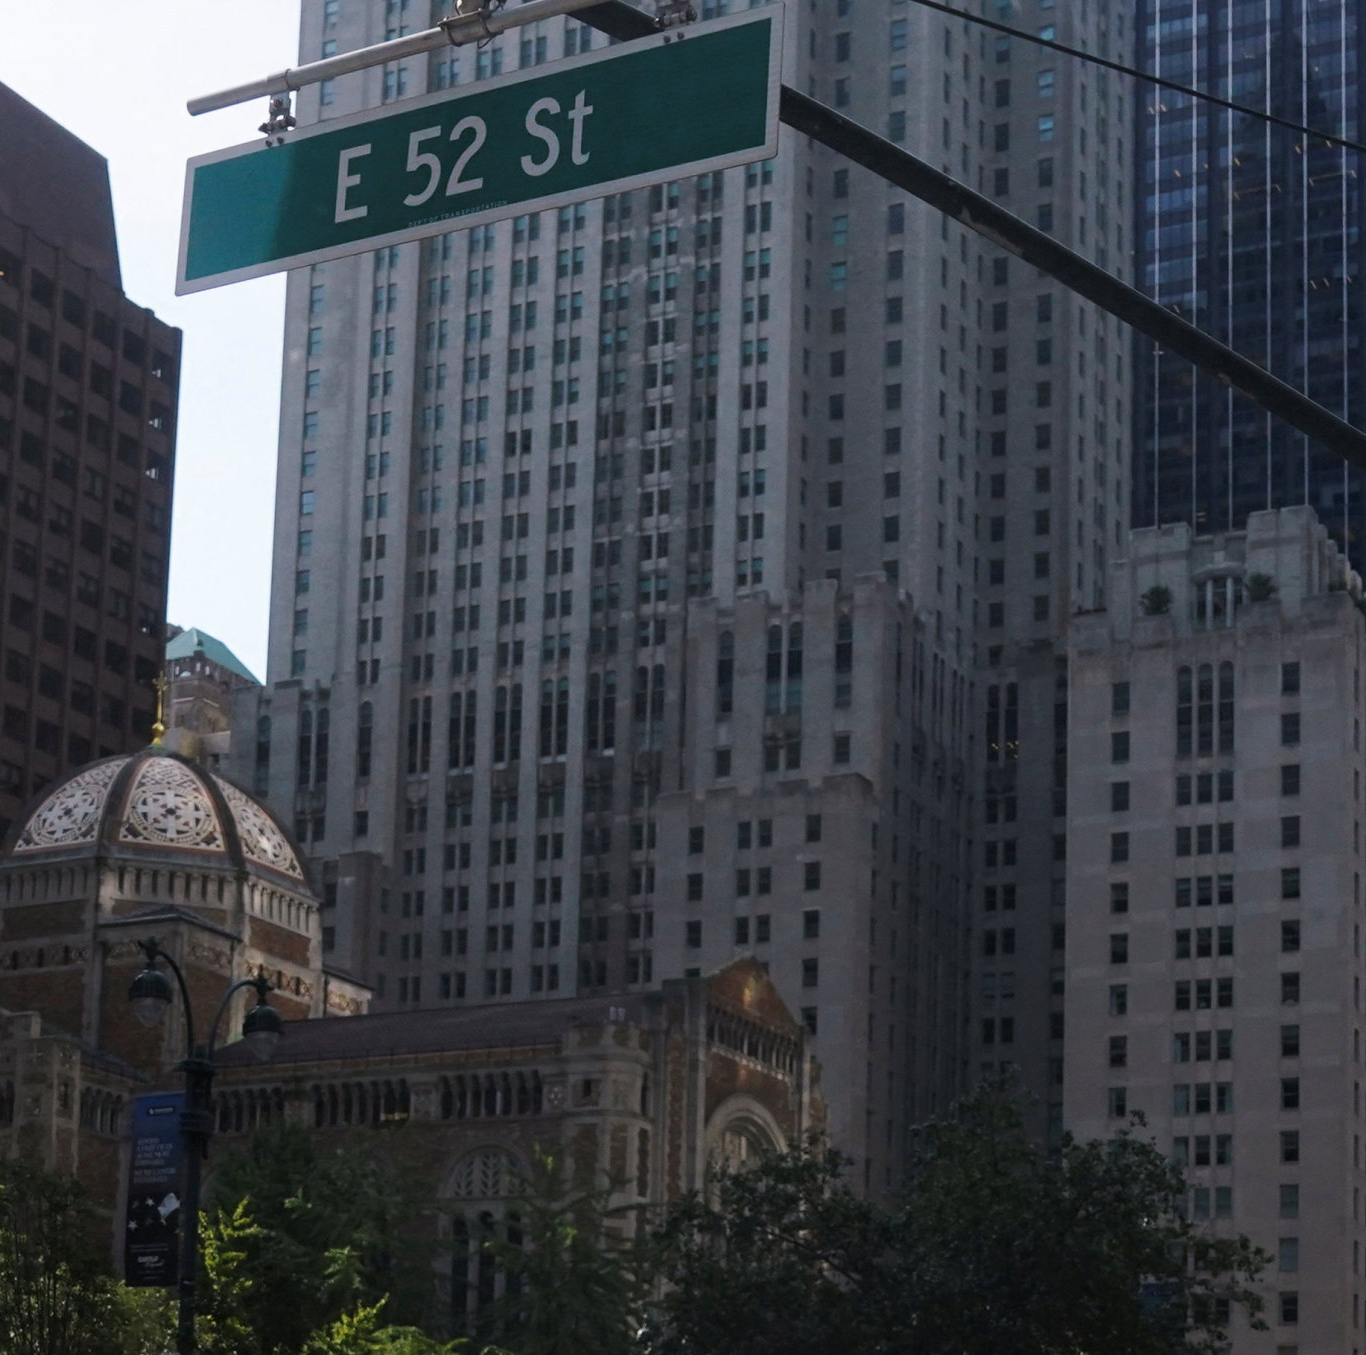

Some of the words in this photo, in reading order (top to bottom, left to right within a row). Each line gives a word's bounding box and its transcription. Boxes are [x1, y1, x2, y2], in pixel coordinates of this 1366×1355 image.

[334, 142, 372, 224] E
[402, 115, 488, 207] 52
[520, 88, 594, 177] St
[440, 200, 508, 220] TRANSPORTATION
